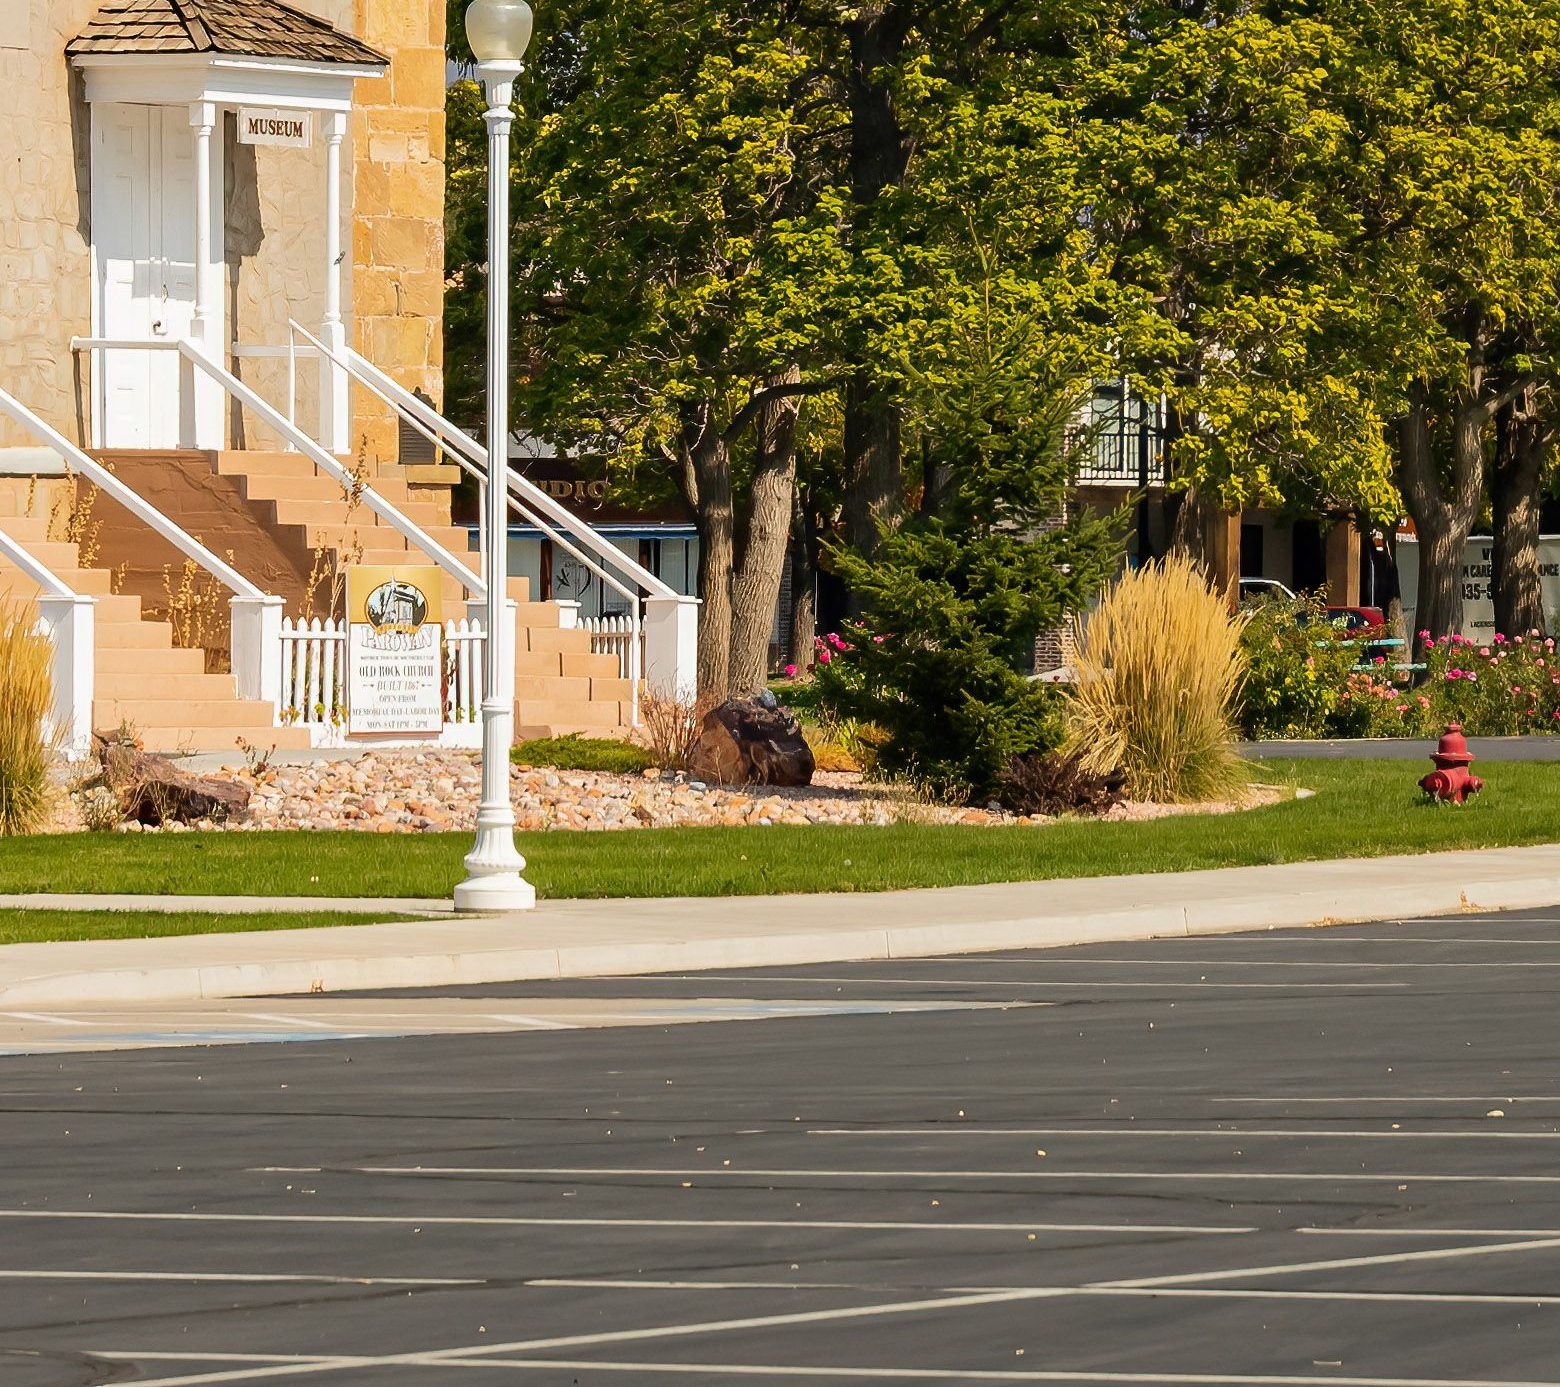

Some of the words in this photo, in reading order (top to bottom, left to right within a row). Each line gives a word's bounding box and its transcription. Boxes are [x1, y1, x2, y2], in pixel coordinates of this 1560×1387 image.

[248, 117, 304, 138] MUSEUM
[359, 666, 376, 677] OLD
[379, 666, 400, 677] ROCK
[403, 666, 434, 677] CHURCH
